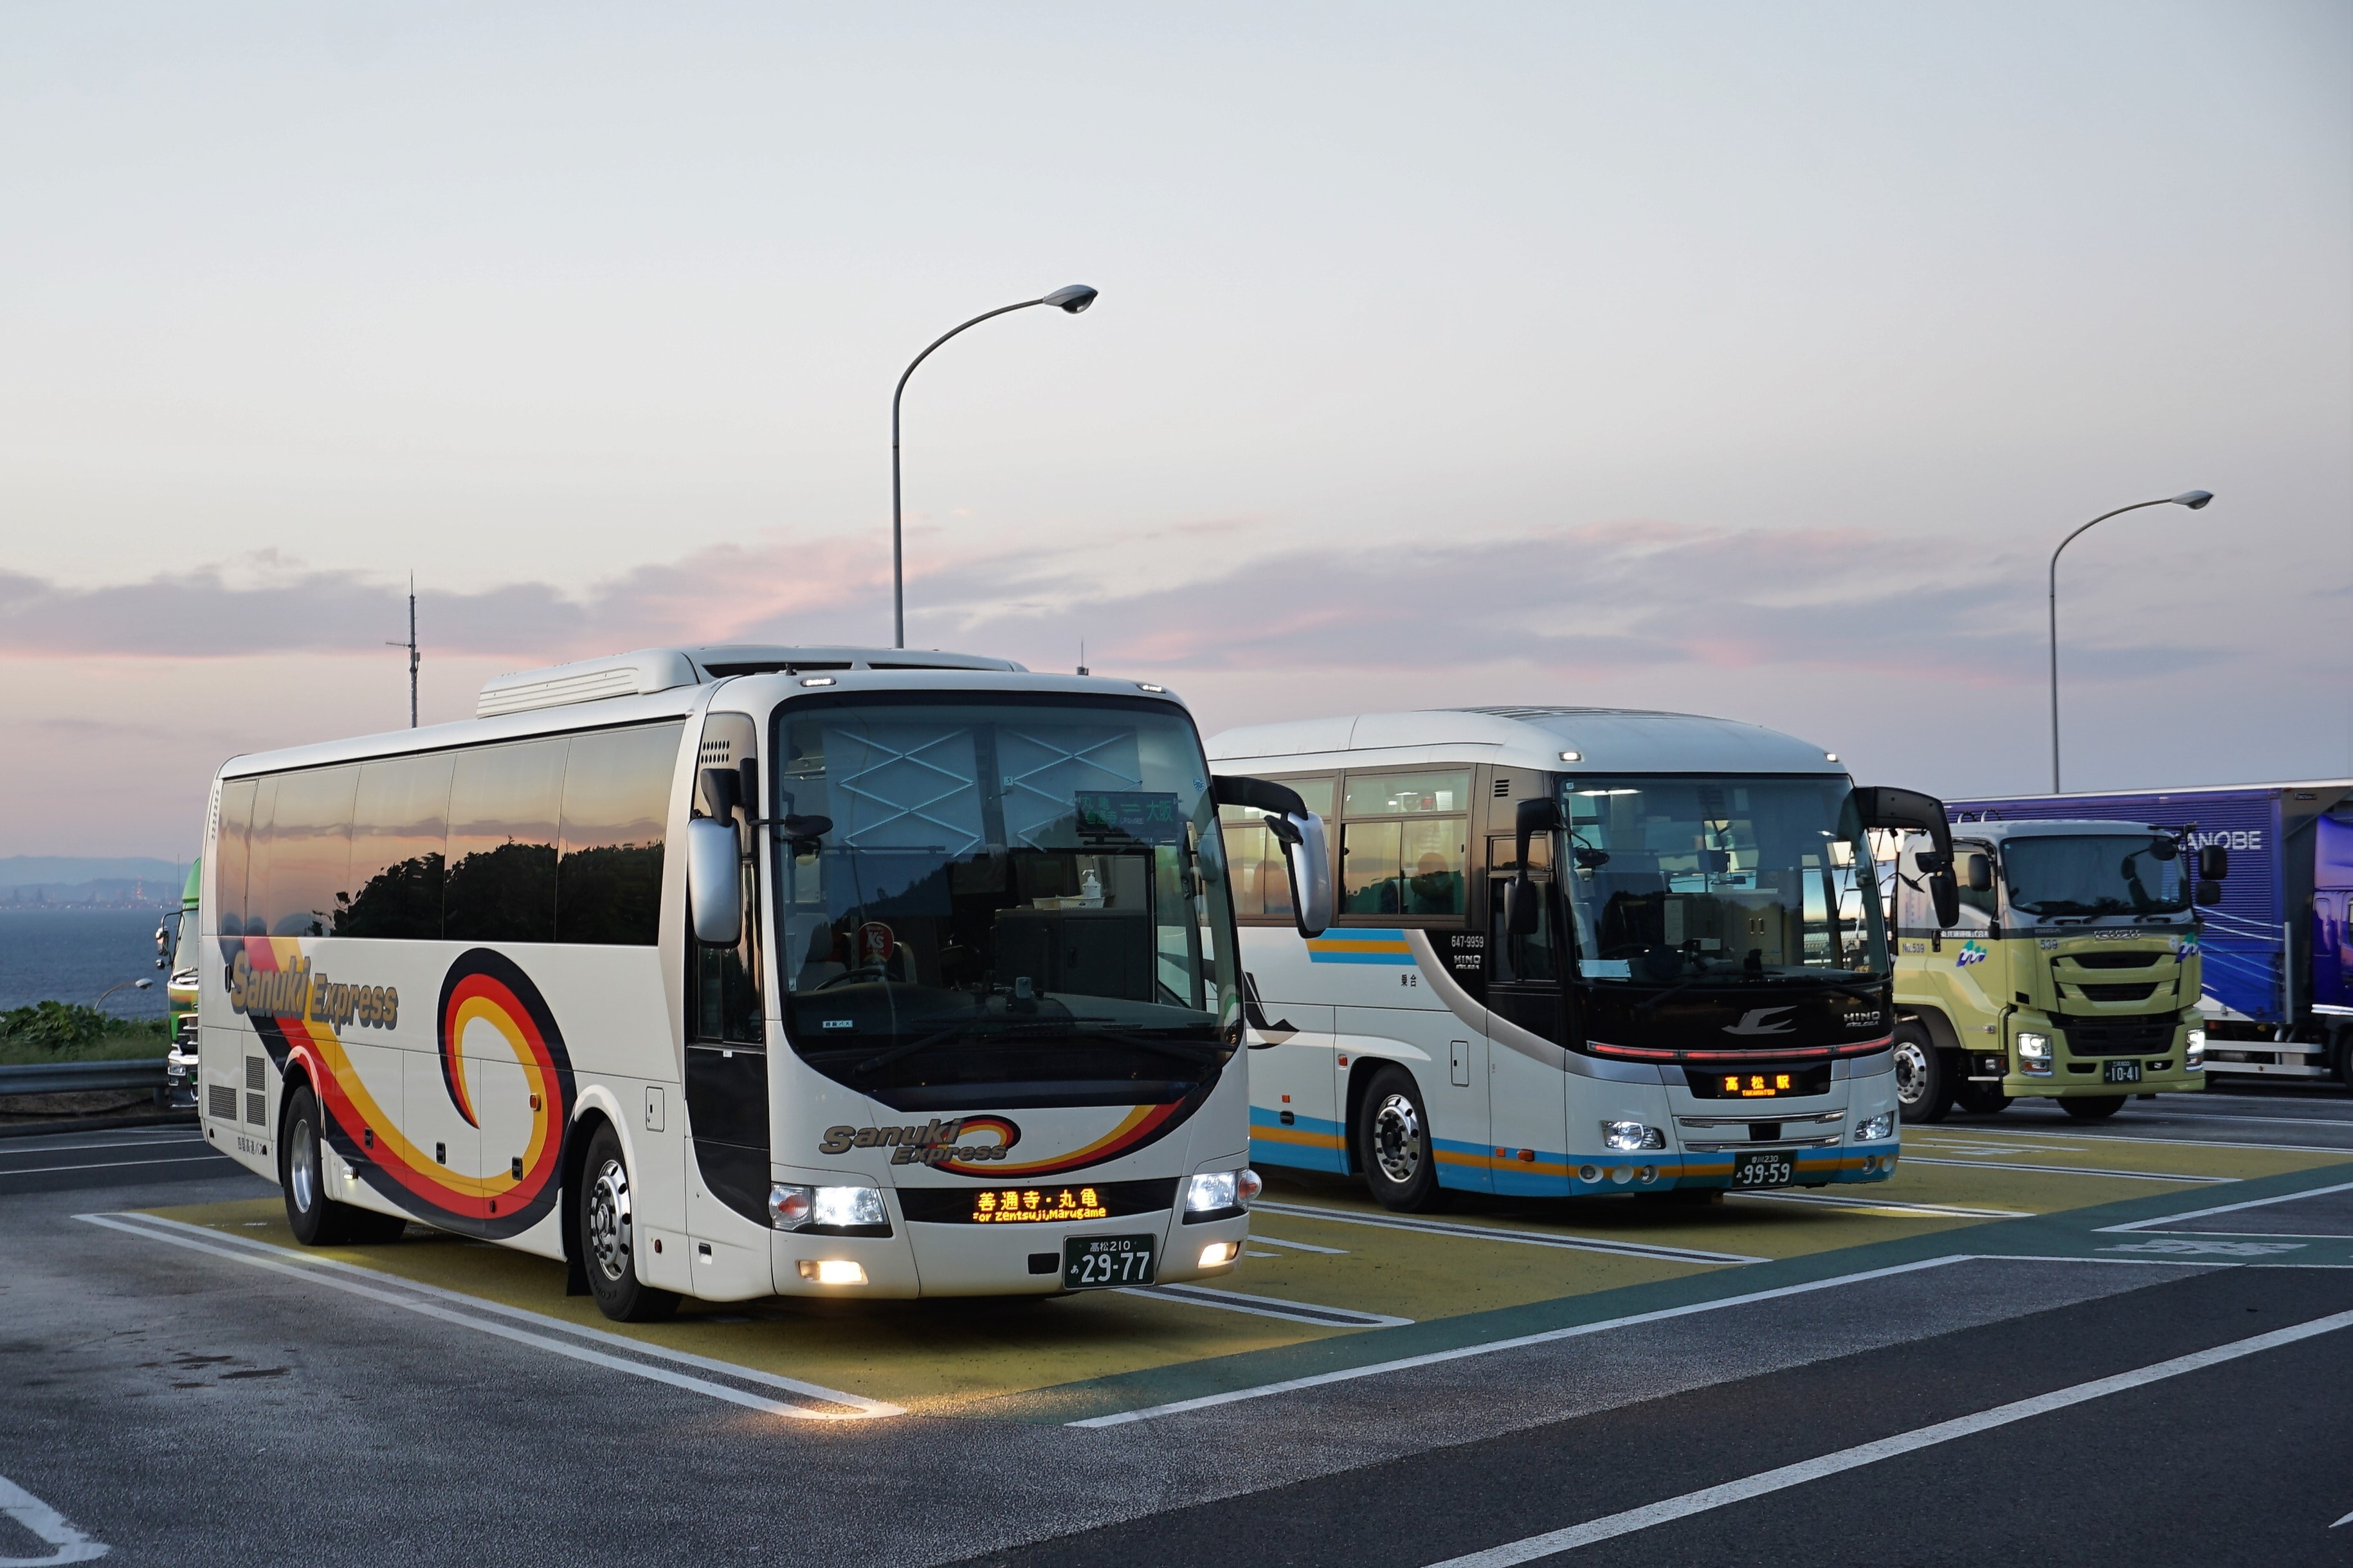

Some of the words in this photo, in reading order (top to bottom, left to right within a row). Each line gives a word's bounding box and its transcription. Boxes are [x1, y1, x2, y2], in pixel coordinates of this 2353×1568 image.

[1147, 800, 1173, 822] 大阪
[2174, 831, 2262, 852] ANOBE
[1451, 935, 1484, 948] 647-9959
[2040, 939, 2058, 950] 539
[2094, 930, 2140, 941] ISUZU
[1902, 942, 1925, 953] No.539
[1454, 955, 1481, 964] HINO
[231, 950, 311, 1020] Sanuki
[311, 973, 399, 1036] Express
[1844, 1011, 1880, 1022] HINO
[2111, 1066, 2140, 1081] 10-41
[1725, 1075, 1790, 1091] 高松駅
[819, 1118, 964, 1155] Sanuki
[890, 1146, 1007, 1166] Express
[1743, 1163, 1791, 1184] 99-59
[977, 1188, 1098, 1211] 善通寺・丸亀
[1081, 1251, 1150, 1283] 29-77
